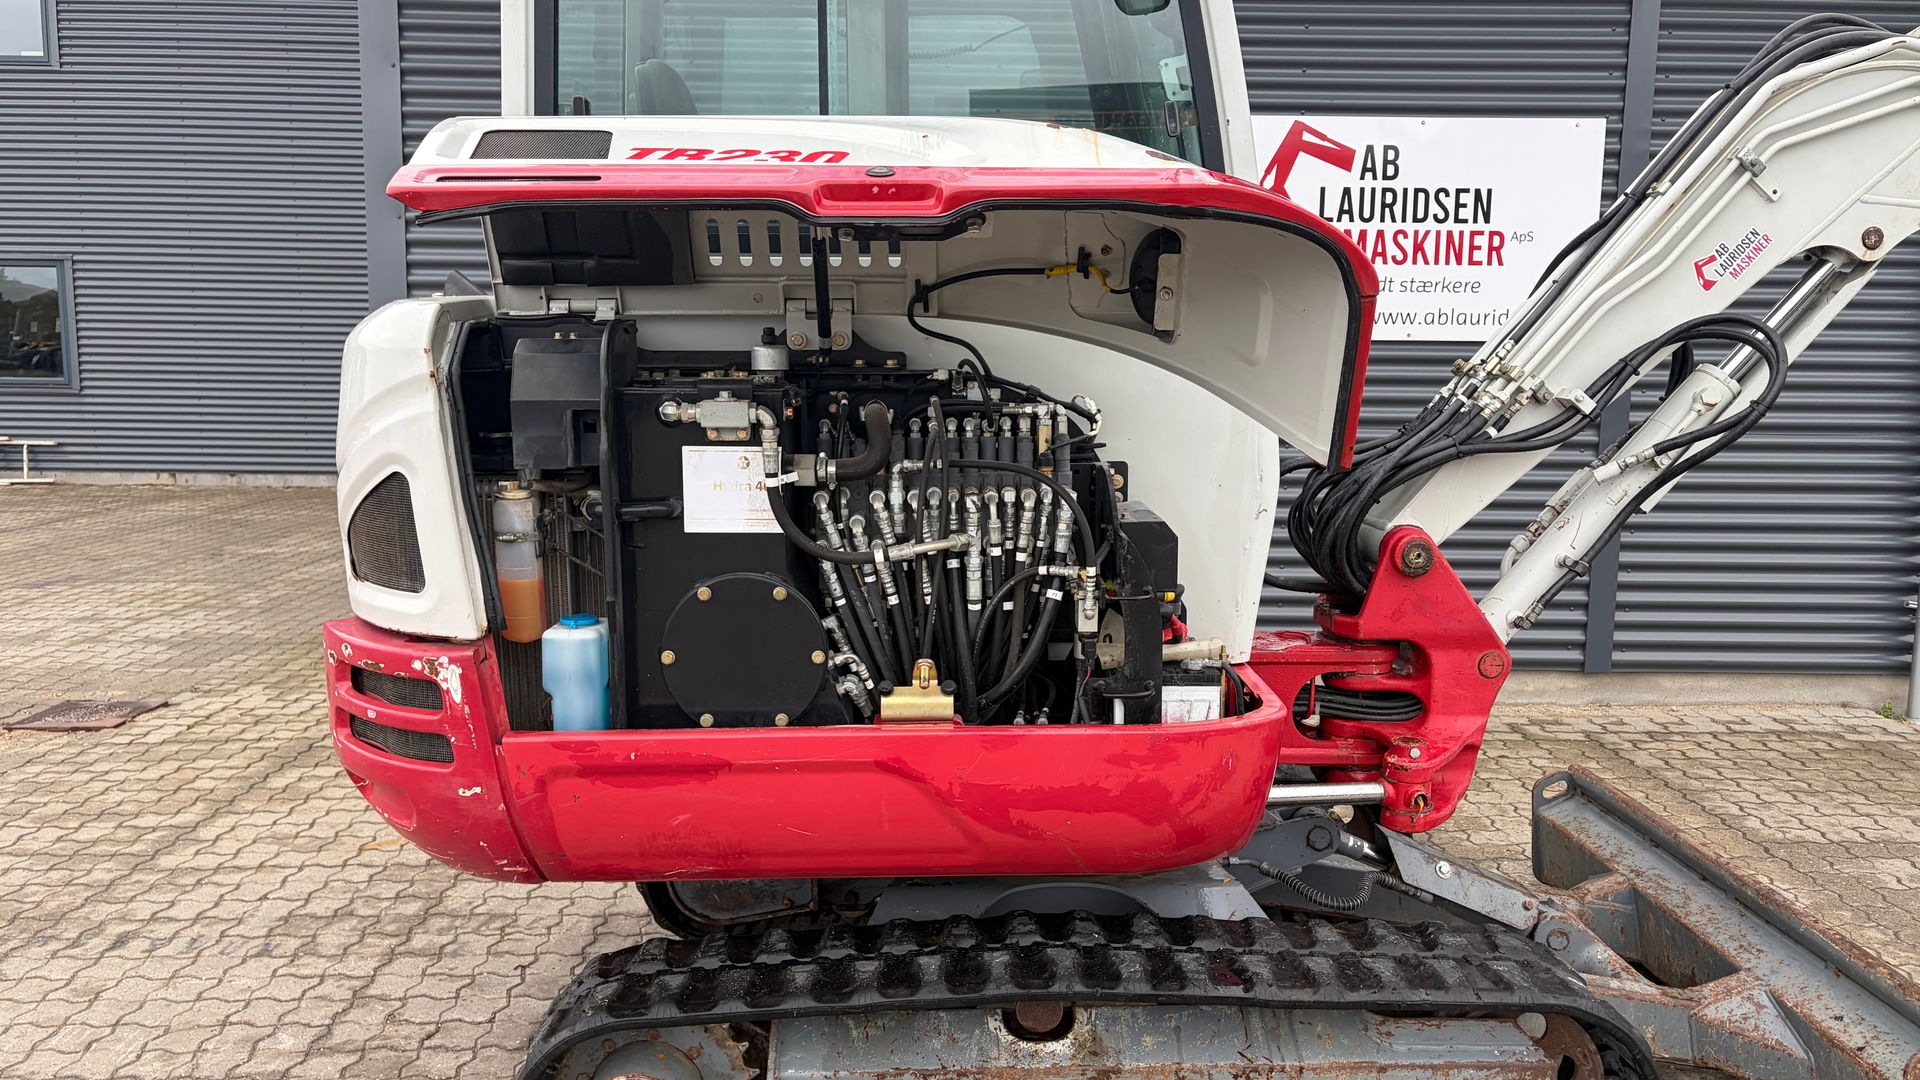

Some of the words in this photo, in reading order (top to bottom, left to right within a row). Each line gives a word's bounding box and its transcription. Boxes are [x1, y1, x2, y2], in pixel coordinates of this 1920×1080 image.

[1359, 144, 1400, 181] AB
[1319, 186, 1492, 224] LAURIDSEN
[1510, 231, 1534, 244] ApS
[1714, 242, 1730, 259] AB
[1714, 227, 1761, 278] LAURIDSEN
[1729, 233, 1773, 280] MASKINER
[1399, 276, 1481, 293] stærkere
[1374, 307, 1509, 326] ww.ablaurid
